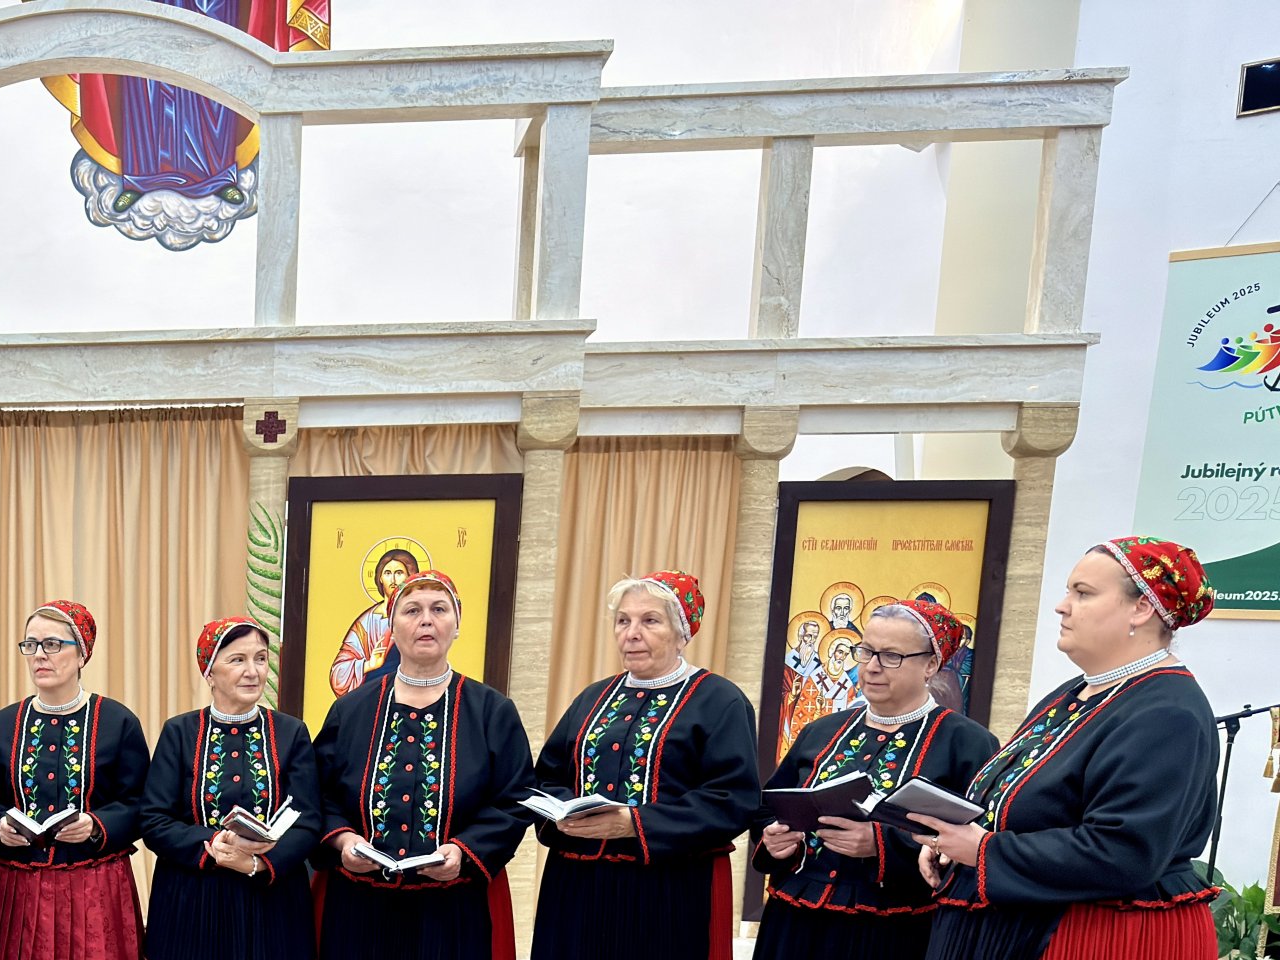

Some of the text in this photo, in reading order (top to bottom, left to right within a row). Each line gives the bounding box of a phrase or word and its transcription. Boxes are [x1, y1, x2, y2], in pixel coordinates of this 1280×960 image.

[1187, 282, 1261, 347] JUBILEUM 2025
[1180, 462, 1280, 482] Jubilejný r
